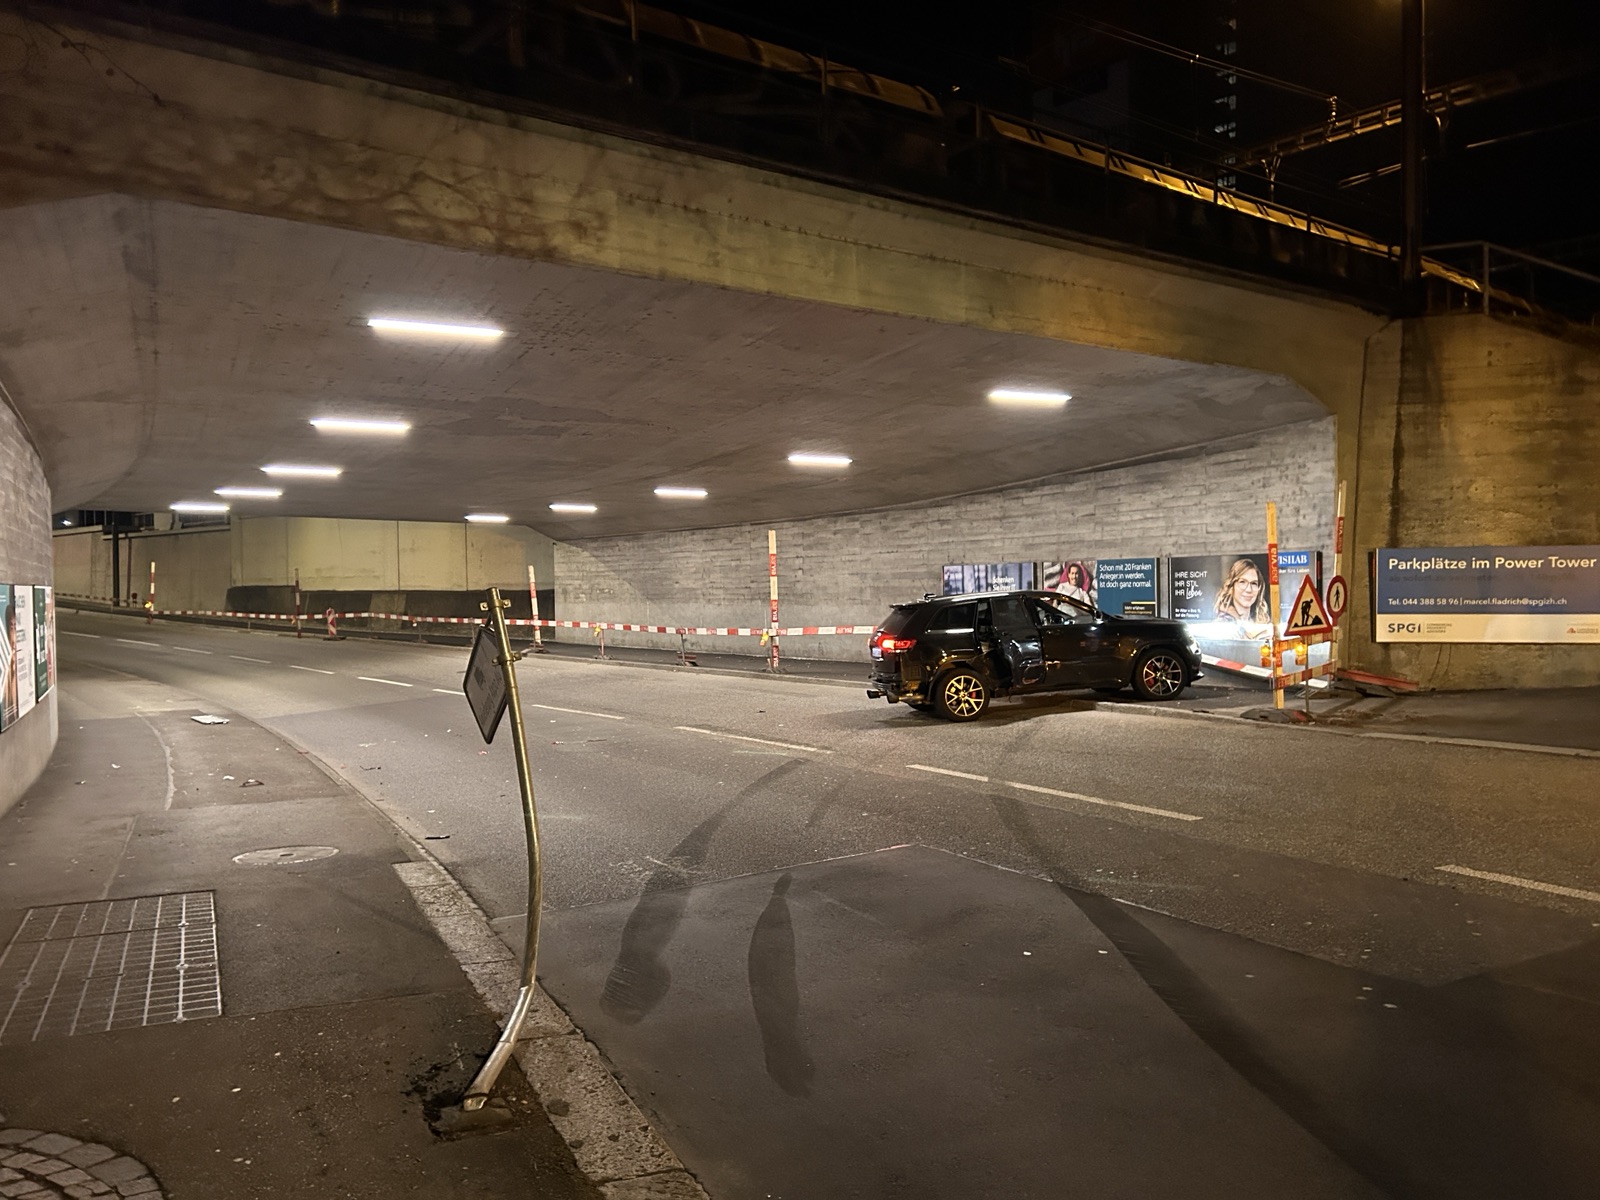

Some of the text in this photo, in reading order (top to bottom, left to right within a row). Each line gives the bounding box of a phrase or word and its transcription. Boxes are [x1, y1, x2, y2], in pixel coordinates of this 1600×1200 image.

[1278, 555, 1307, 564] ISILAB
[1389, 556, 1597, 572] Parkplätze im Power Tower
[1106, 580, 1118, 588] doch
[1120, 581, 1132, 589] ganz
[1388, 623, 1421, 633] SPGI
